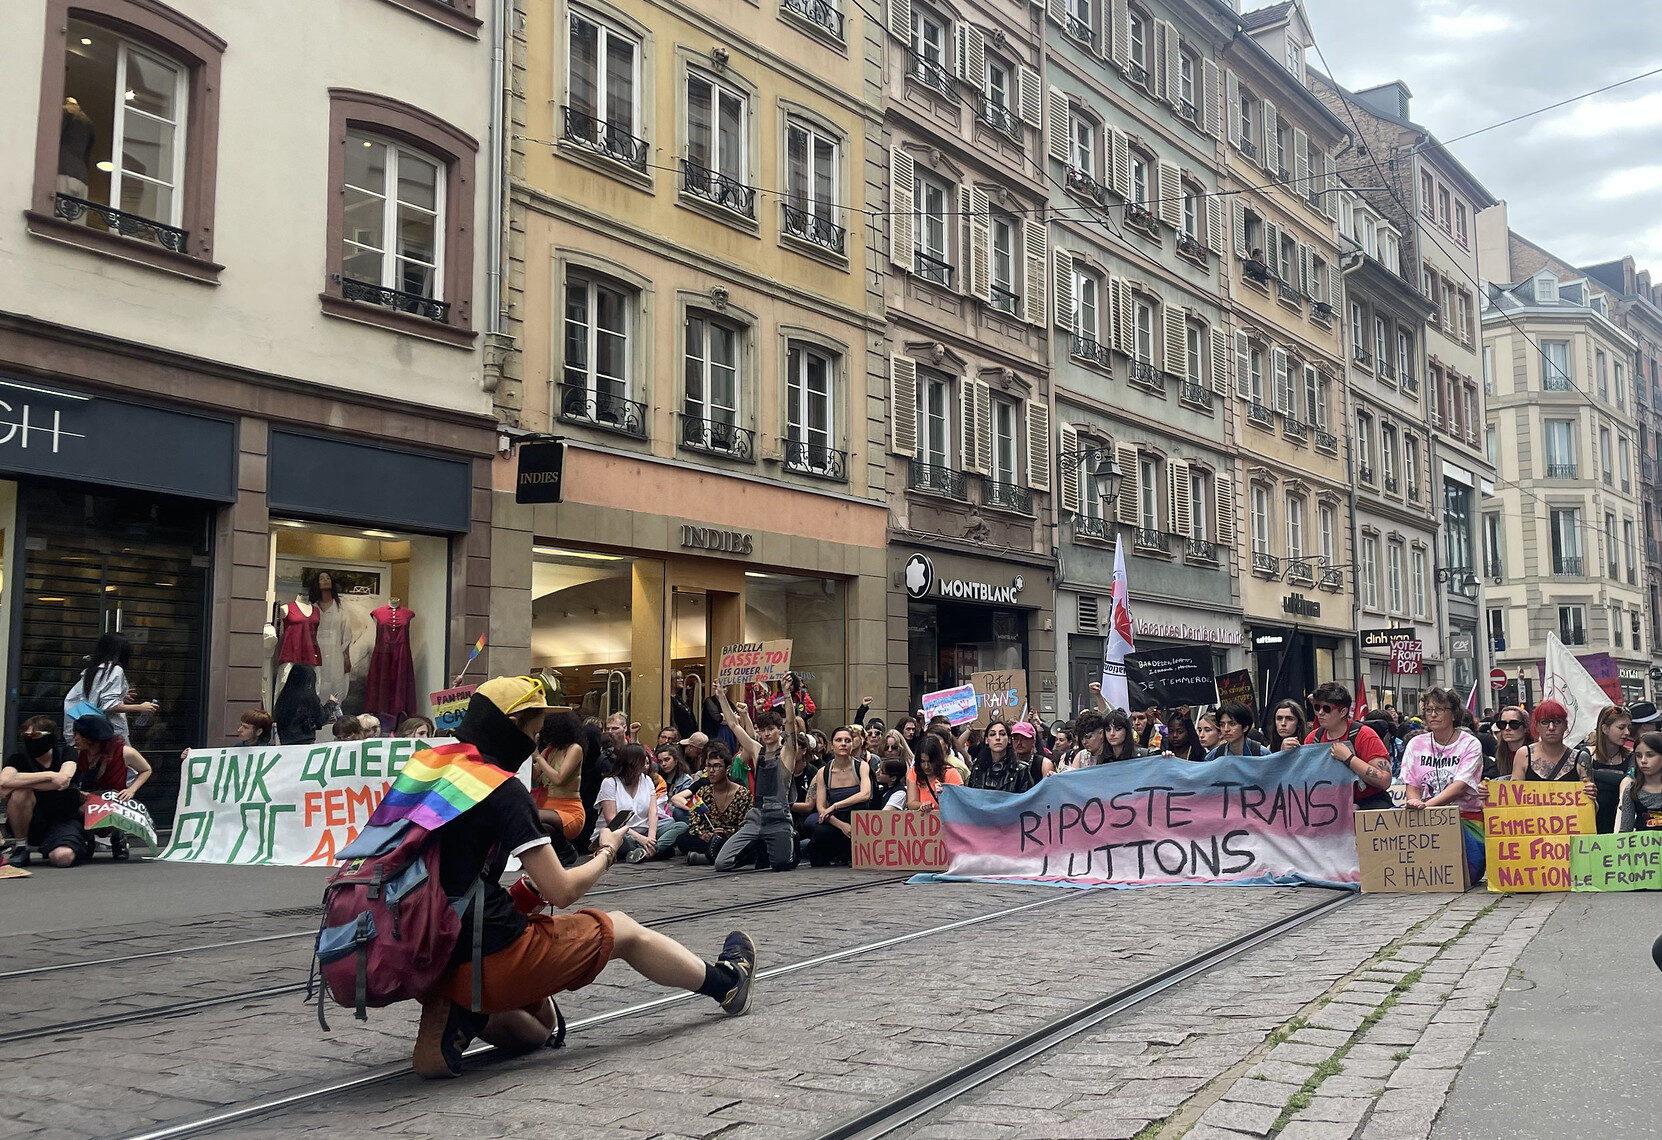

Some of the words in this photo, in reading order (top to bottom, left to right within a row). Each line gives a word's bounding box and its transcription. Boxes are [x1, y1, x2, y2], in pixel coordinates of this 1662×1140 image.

[520, 472, 559, 484] INDIES
[681, 524, 754, 555] INDIES
[938, 578, 1018, 604] MONTBLANC
[1136, 617, 1180, 639] Vacances
[1216, 627, 1245, 644] Minute
[1366, 632, 1388, 644] dinh
[722, 643, 763, 656] BARDELLA
[1390, 641, 1423, 651] VOTEZ
[1391, 650, 1423, 661] FRONT
[720, 667, 732, 677] LES
[733, 666, 760, 676] QUEER
[764, 665, 775, 673] NE
[1397, 660, 1418, 674] POP.
[718, 674, 753, 686] VEULENT
[755, 673, 768, 682] PAS
[1138, 681, 1156, 693] JE
[976, 688, 1019, 708] TRANS
[1211, 781, 1339, 829] TRANS
[855, 812, 883, 837] NO
[1363, 812, 1389, 833] LA
[1393, 808, 1457, 829] VIELLESSE
[1489, 815, 1581, 835] EMMERDE
[1372, 833, 1441, 852] EMMERDE
[1499, 842, 1522, 861] LE
[1579, 840, 1602, 855] LA
[1399, 851, 1415, 864] LE
[1384, 867, 1397, 887] R
[1575, 874, 1593, 887] LE
[1604, 869, 1656, 885] FRONT
